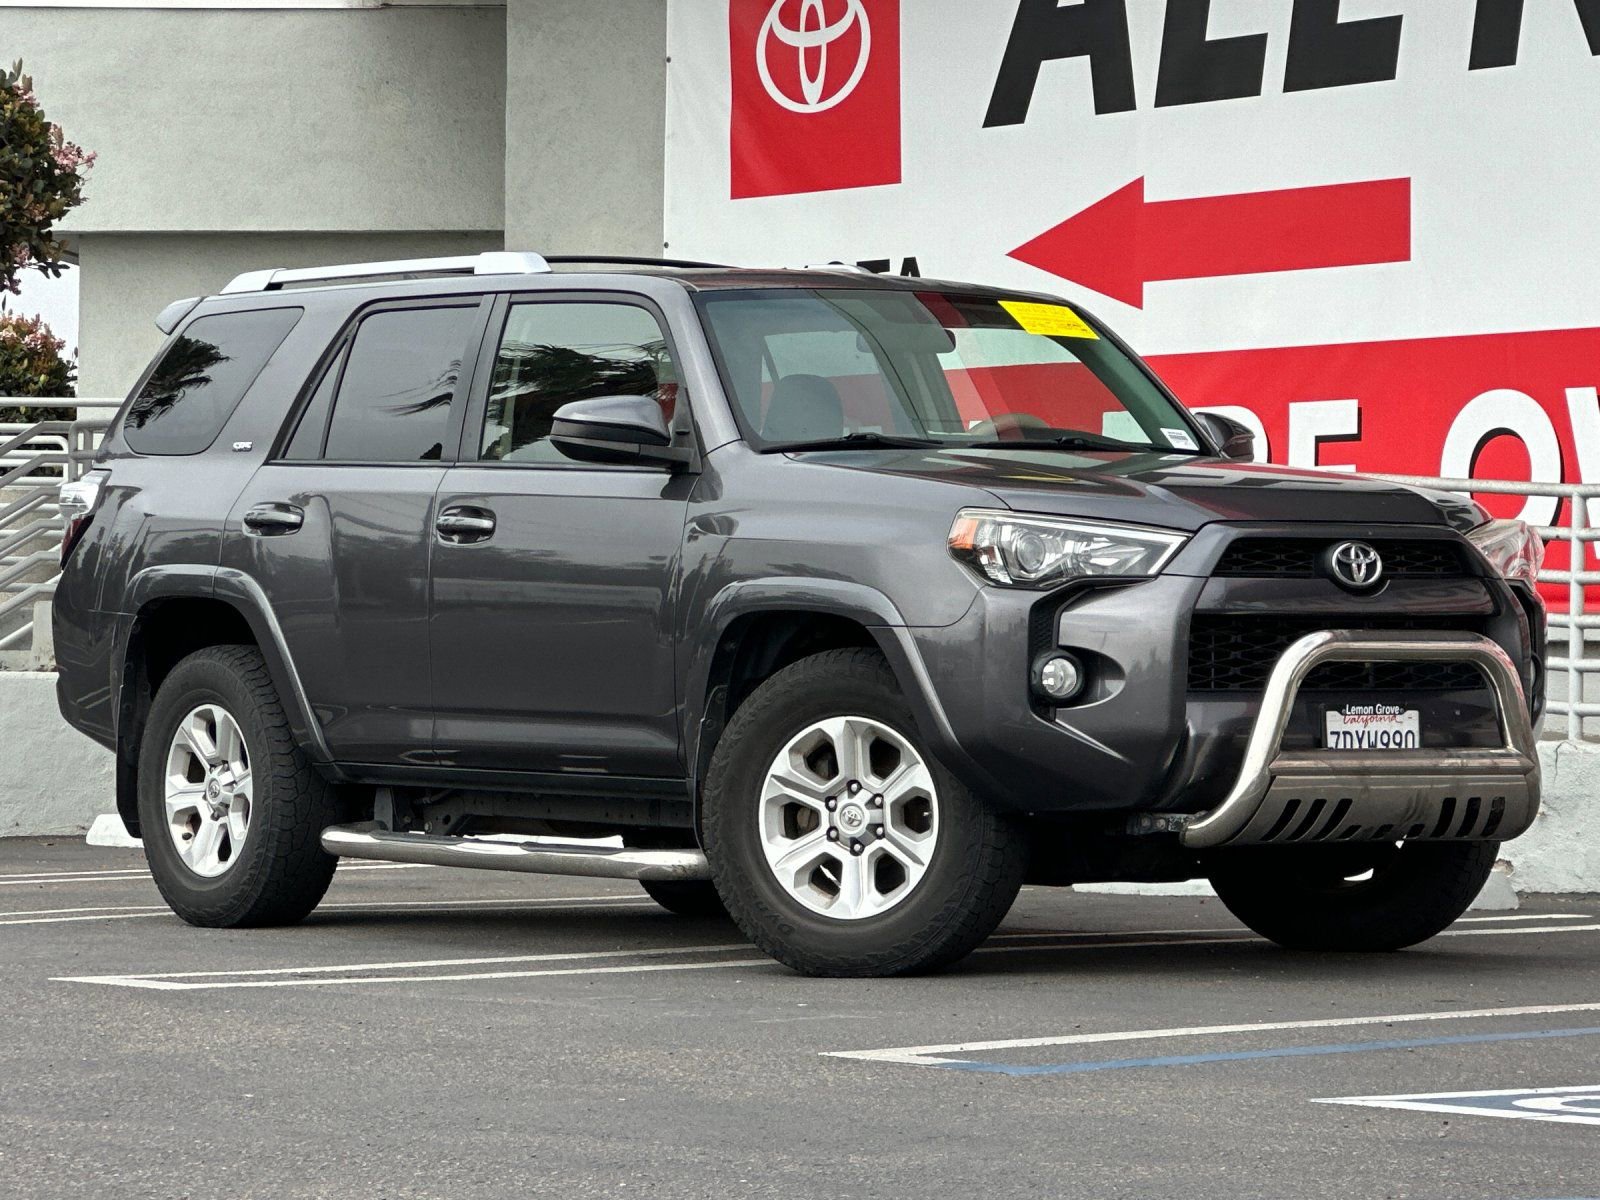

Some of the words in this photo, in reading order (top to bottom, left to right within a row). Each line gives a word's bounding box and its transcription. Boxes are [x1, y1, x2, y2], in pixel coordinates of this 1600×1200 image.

[1346, 704, 1373, 715] Lemon
[1375, 703, 1400, 715] Grove
[1343, 714, 1403, 728] California
